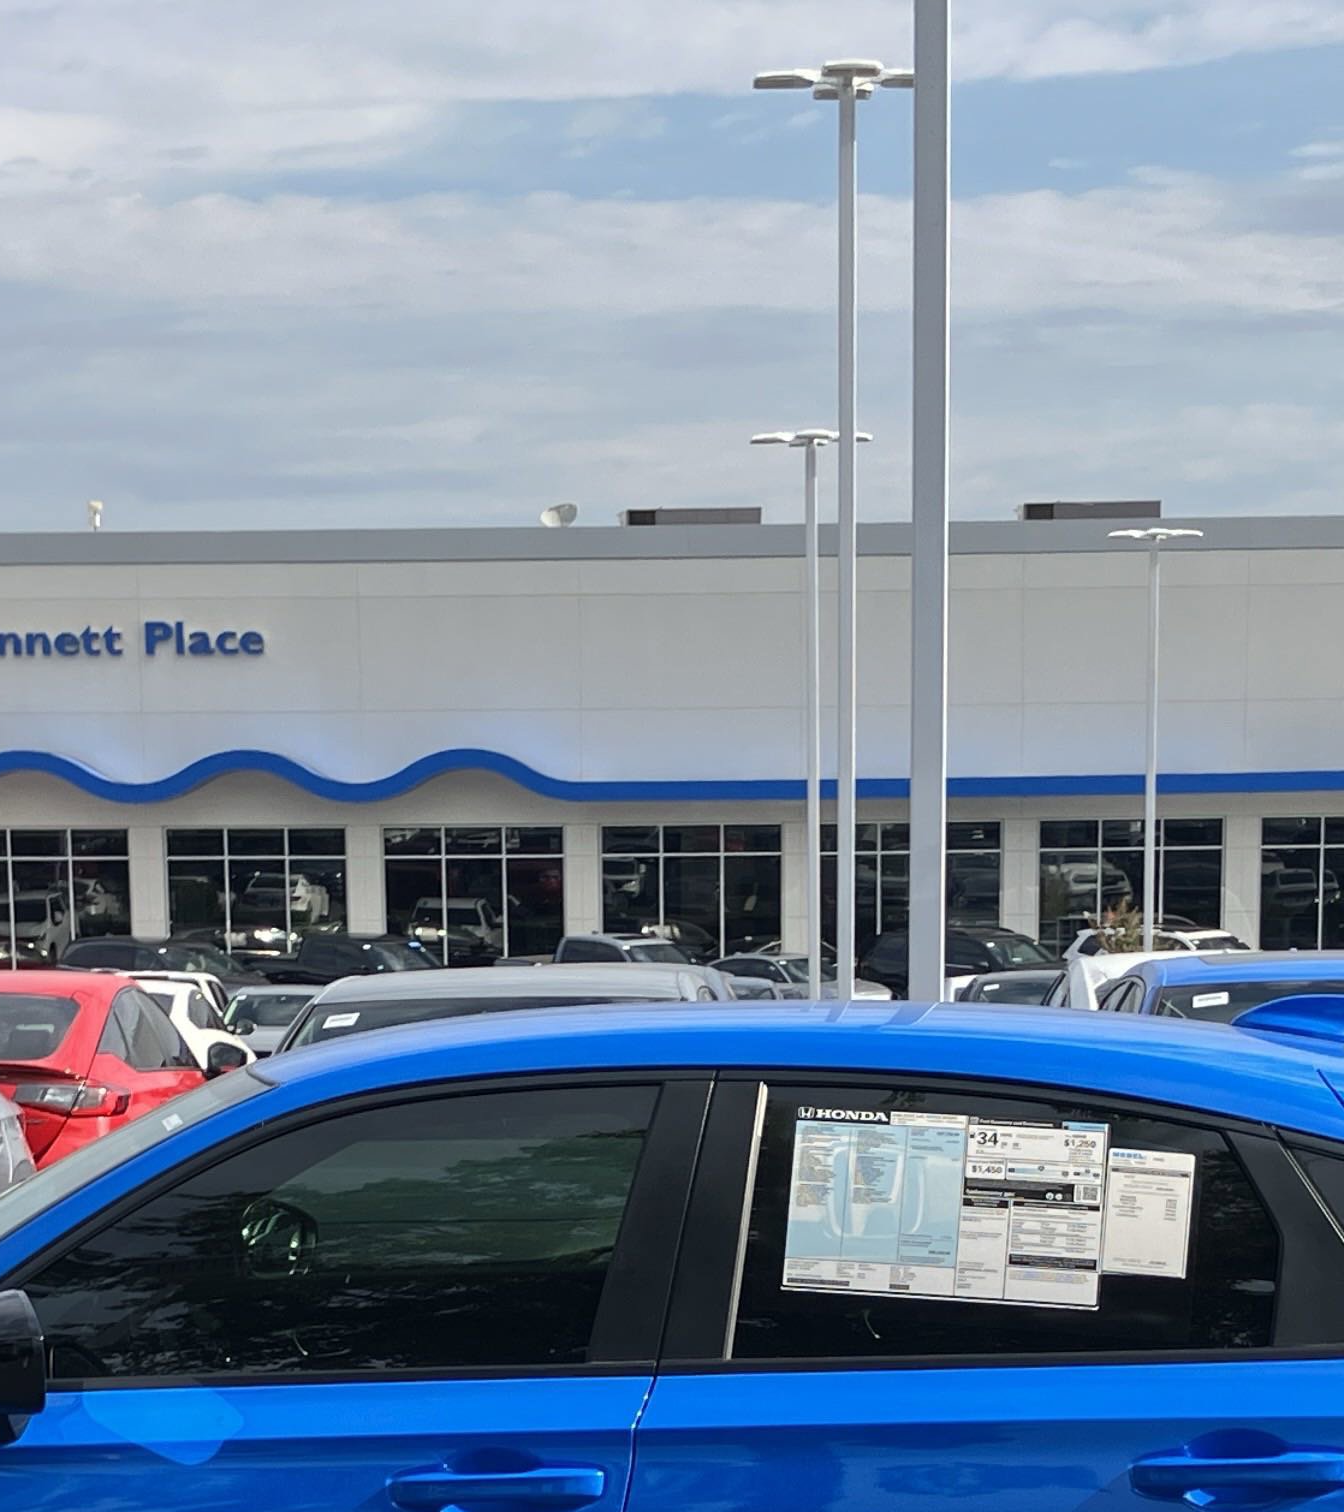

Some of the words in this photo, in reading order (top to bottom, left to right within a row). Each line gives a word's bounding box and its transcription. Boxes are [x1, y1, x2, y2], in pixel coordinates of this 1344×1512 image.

[144, 620, 266, 656] Place
[816, 1109, 889, 1122] HONDA
[976, 1131, 999, 1147] 34
